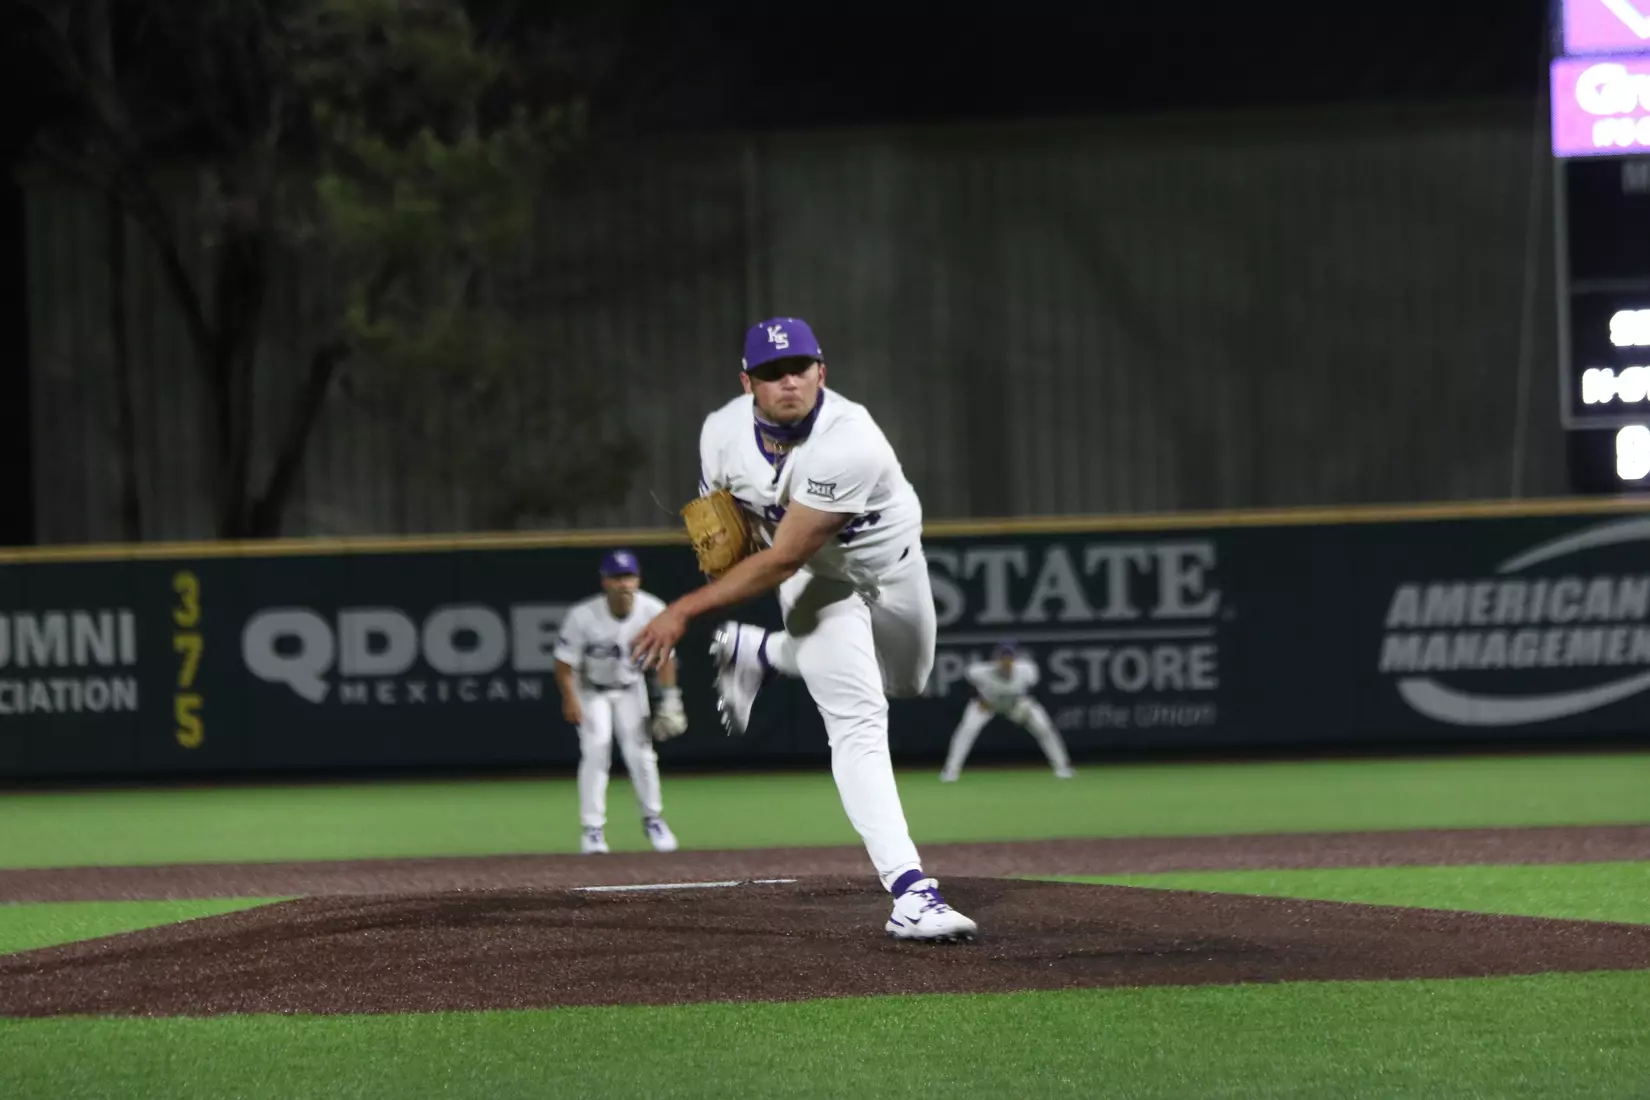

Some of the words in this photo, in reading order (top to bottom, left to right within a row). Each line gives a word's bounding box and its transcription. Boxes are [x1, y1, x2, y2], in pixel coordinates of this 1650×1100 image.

[767, 325, 789, 349] KS
[929, 543, 1221, 626] STATE
[1385, 576, 1650, 629] AMERICAN
[338, 678, 542, 704] MEXICAN
[1047, 646, 1217, 693] STORE
